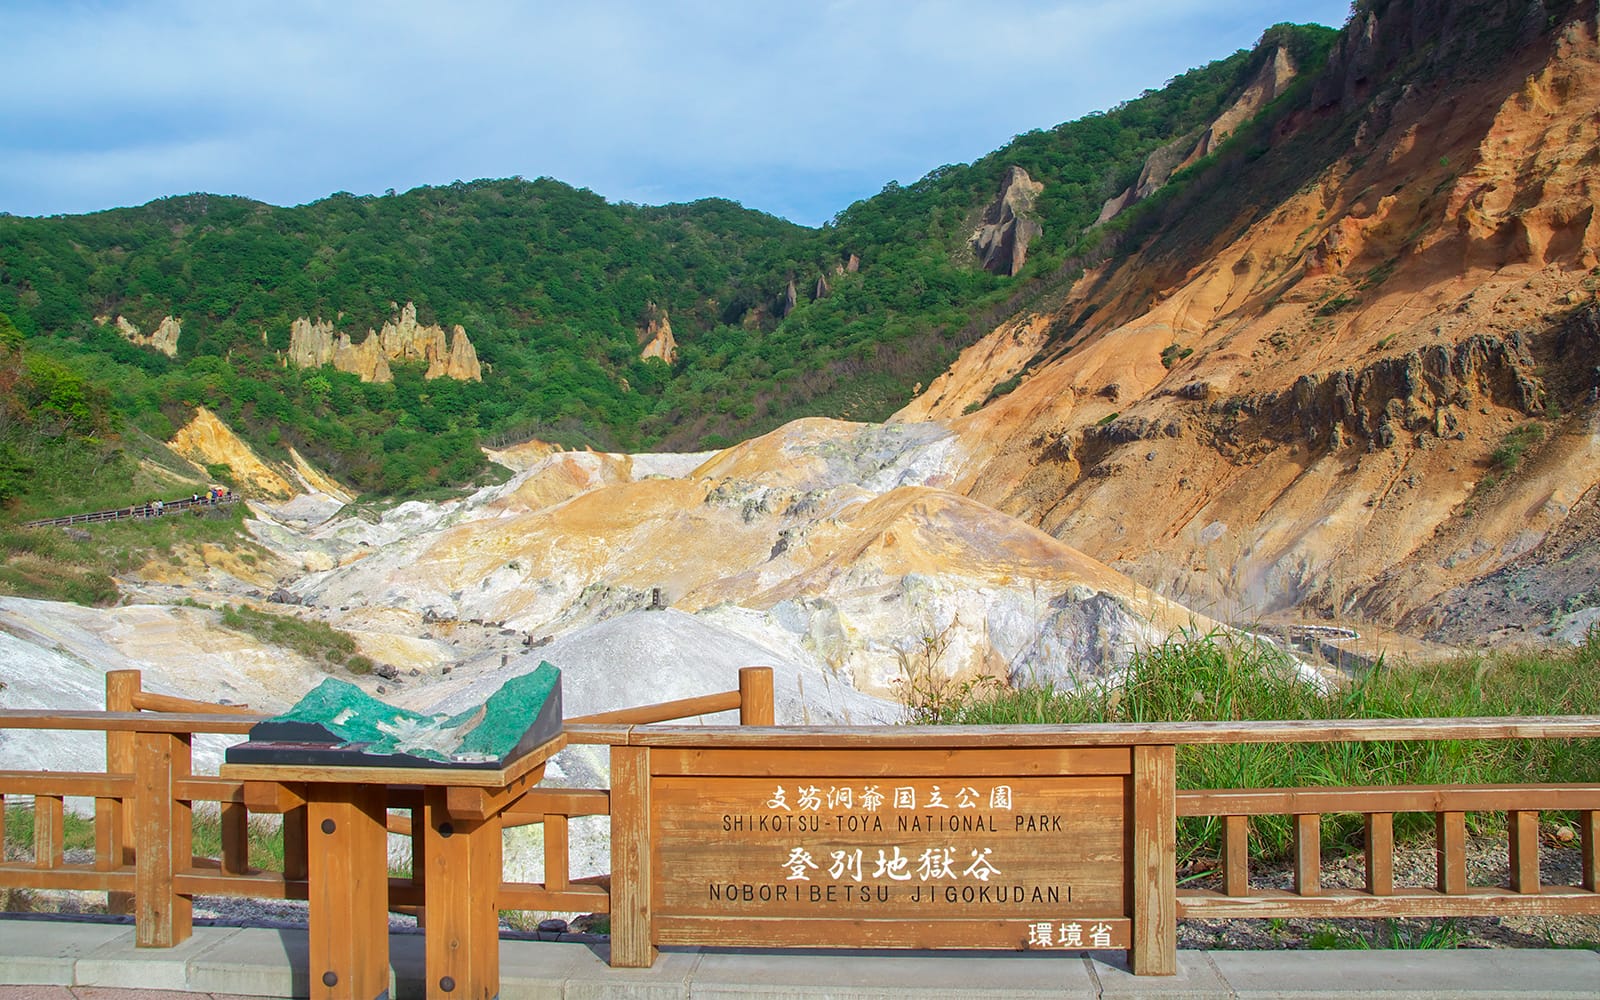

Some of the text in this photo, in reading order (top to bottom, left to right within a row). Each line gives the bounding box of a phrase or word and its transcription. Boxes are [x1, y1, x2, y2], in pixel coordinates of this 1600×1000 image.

[767, 785, 1013, 812] 支笏洞爺国立公園
[722, 814, 1063, 832] SHIKOTSU-TOYA NATIONAL PARK
[781, 846, 1002, 882] 登別地獄谷
[709, 884, 1073, 903] NOBORIBETSU JIGOKUDANI
[1028, 922, 1114, 948] 環境省
